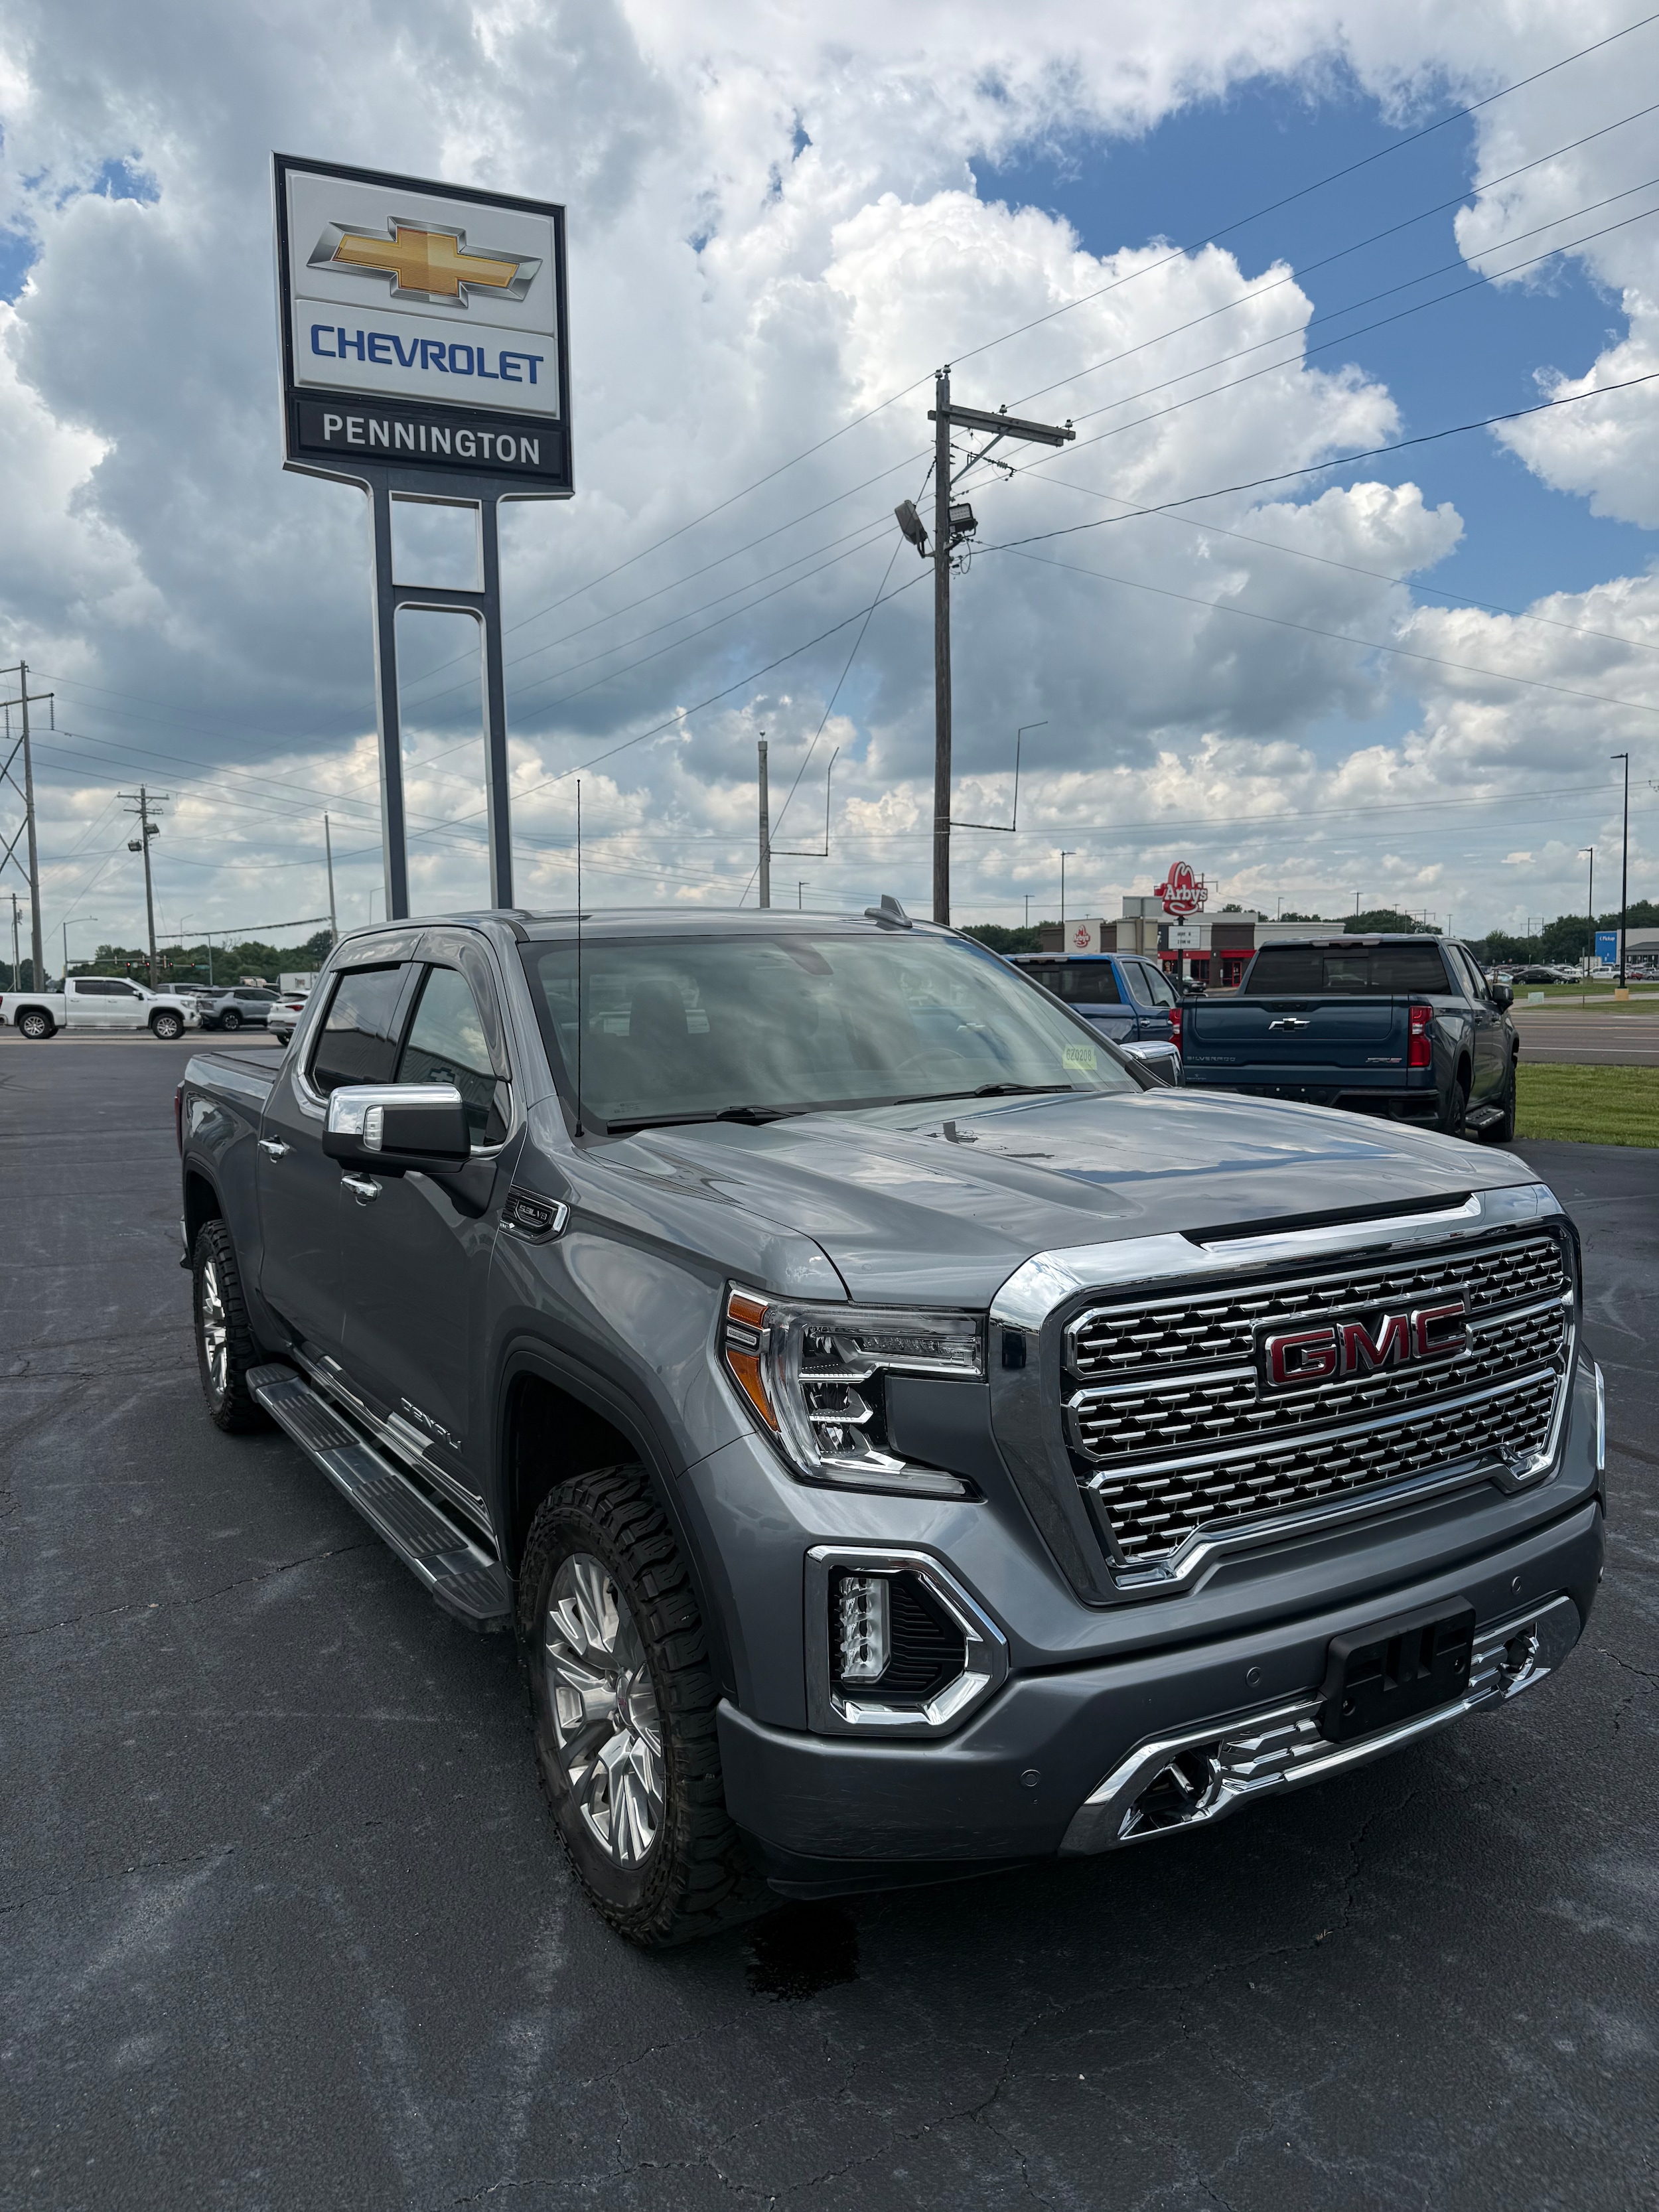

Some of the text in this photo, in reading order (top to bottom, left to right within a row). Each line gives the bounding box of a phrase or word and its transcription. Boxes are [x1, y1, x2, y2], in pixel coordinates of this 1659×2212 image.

[311, 324, 543, 384] CHEVROLET
[323, 413, 540, 465] PENNINGTON
[1264, 1299, 1466, 1387] GMC
[400, 1396, 463, 1454] DENALI
